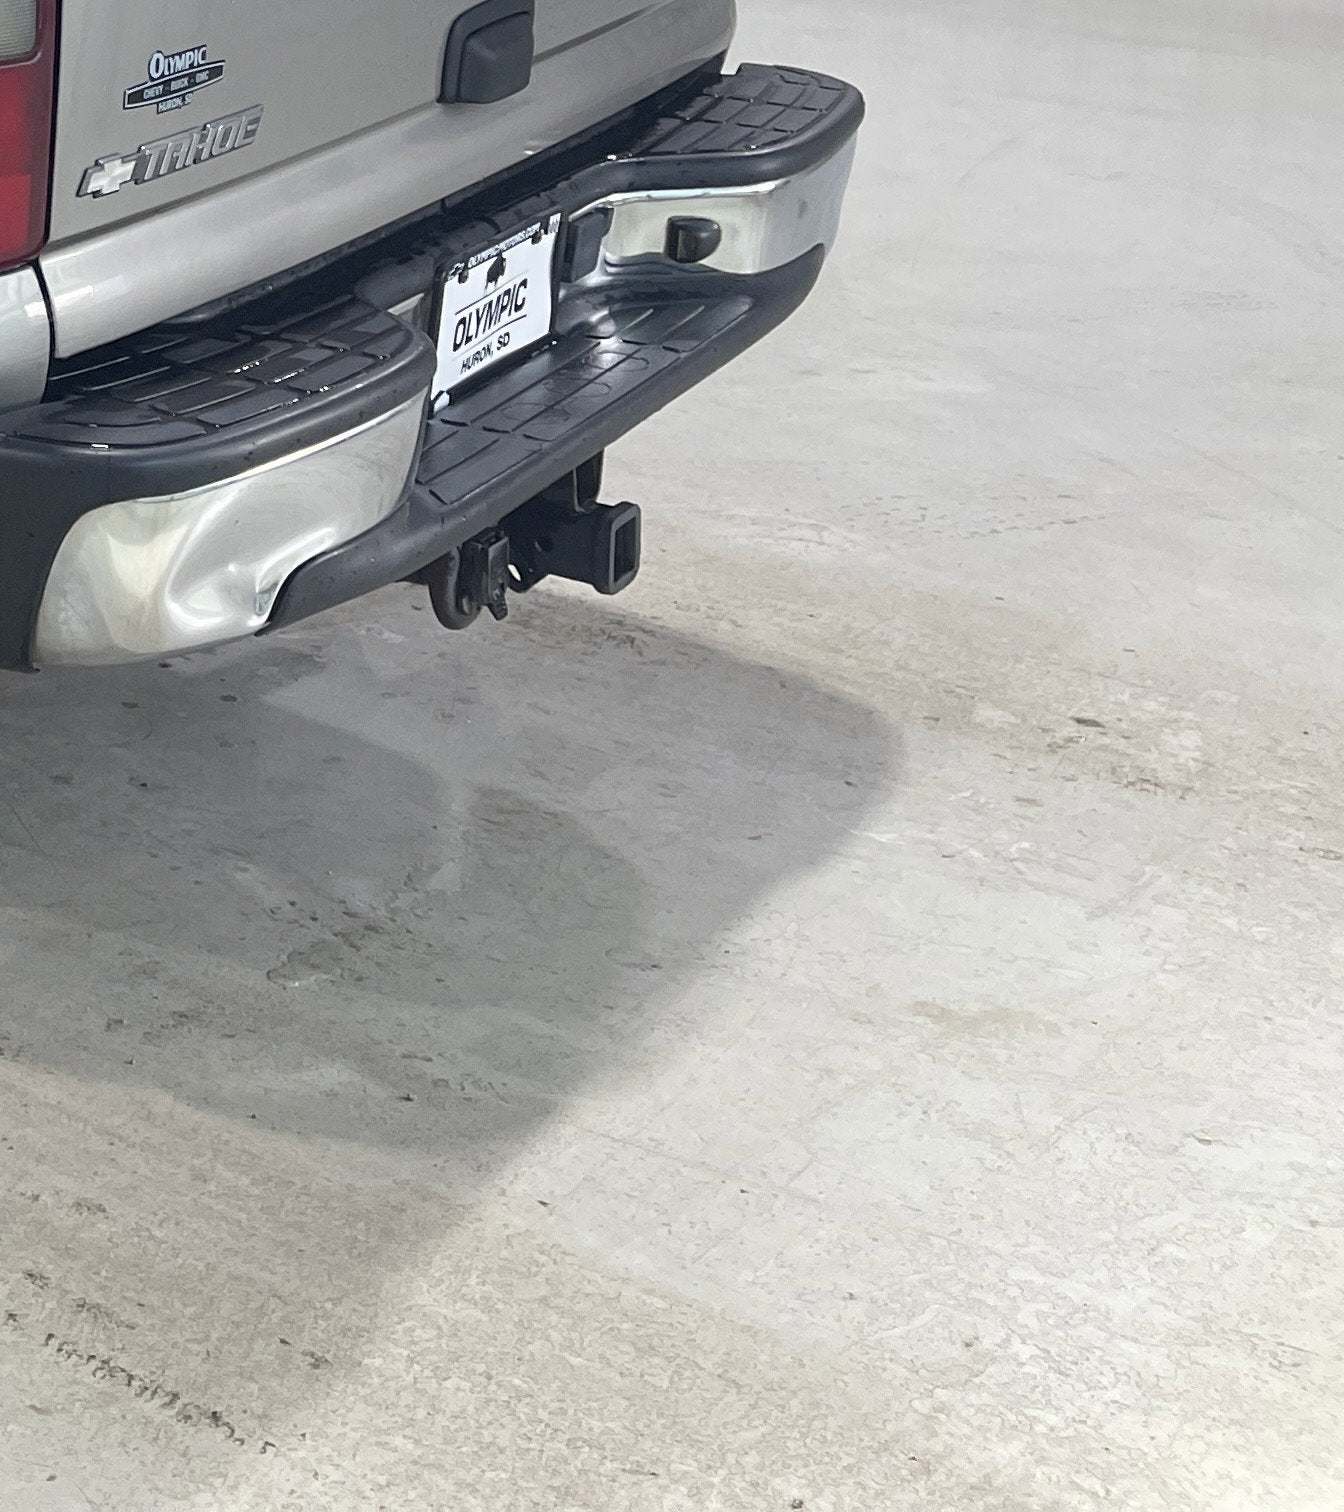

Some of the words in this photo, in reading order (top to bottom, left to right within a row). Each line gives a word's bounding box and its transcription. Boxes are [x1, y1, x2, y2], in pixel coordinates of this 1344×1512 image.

[149, 47, 207, 79] OLYMPIC
[142, 109, 263, 181] TAHOE
[452, 278, 528, 352] OLYMPIC
[460, 343, 494, 375] HURON,
[497, 332, 511, 352] SD
